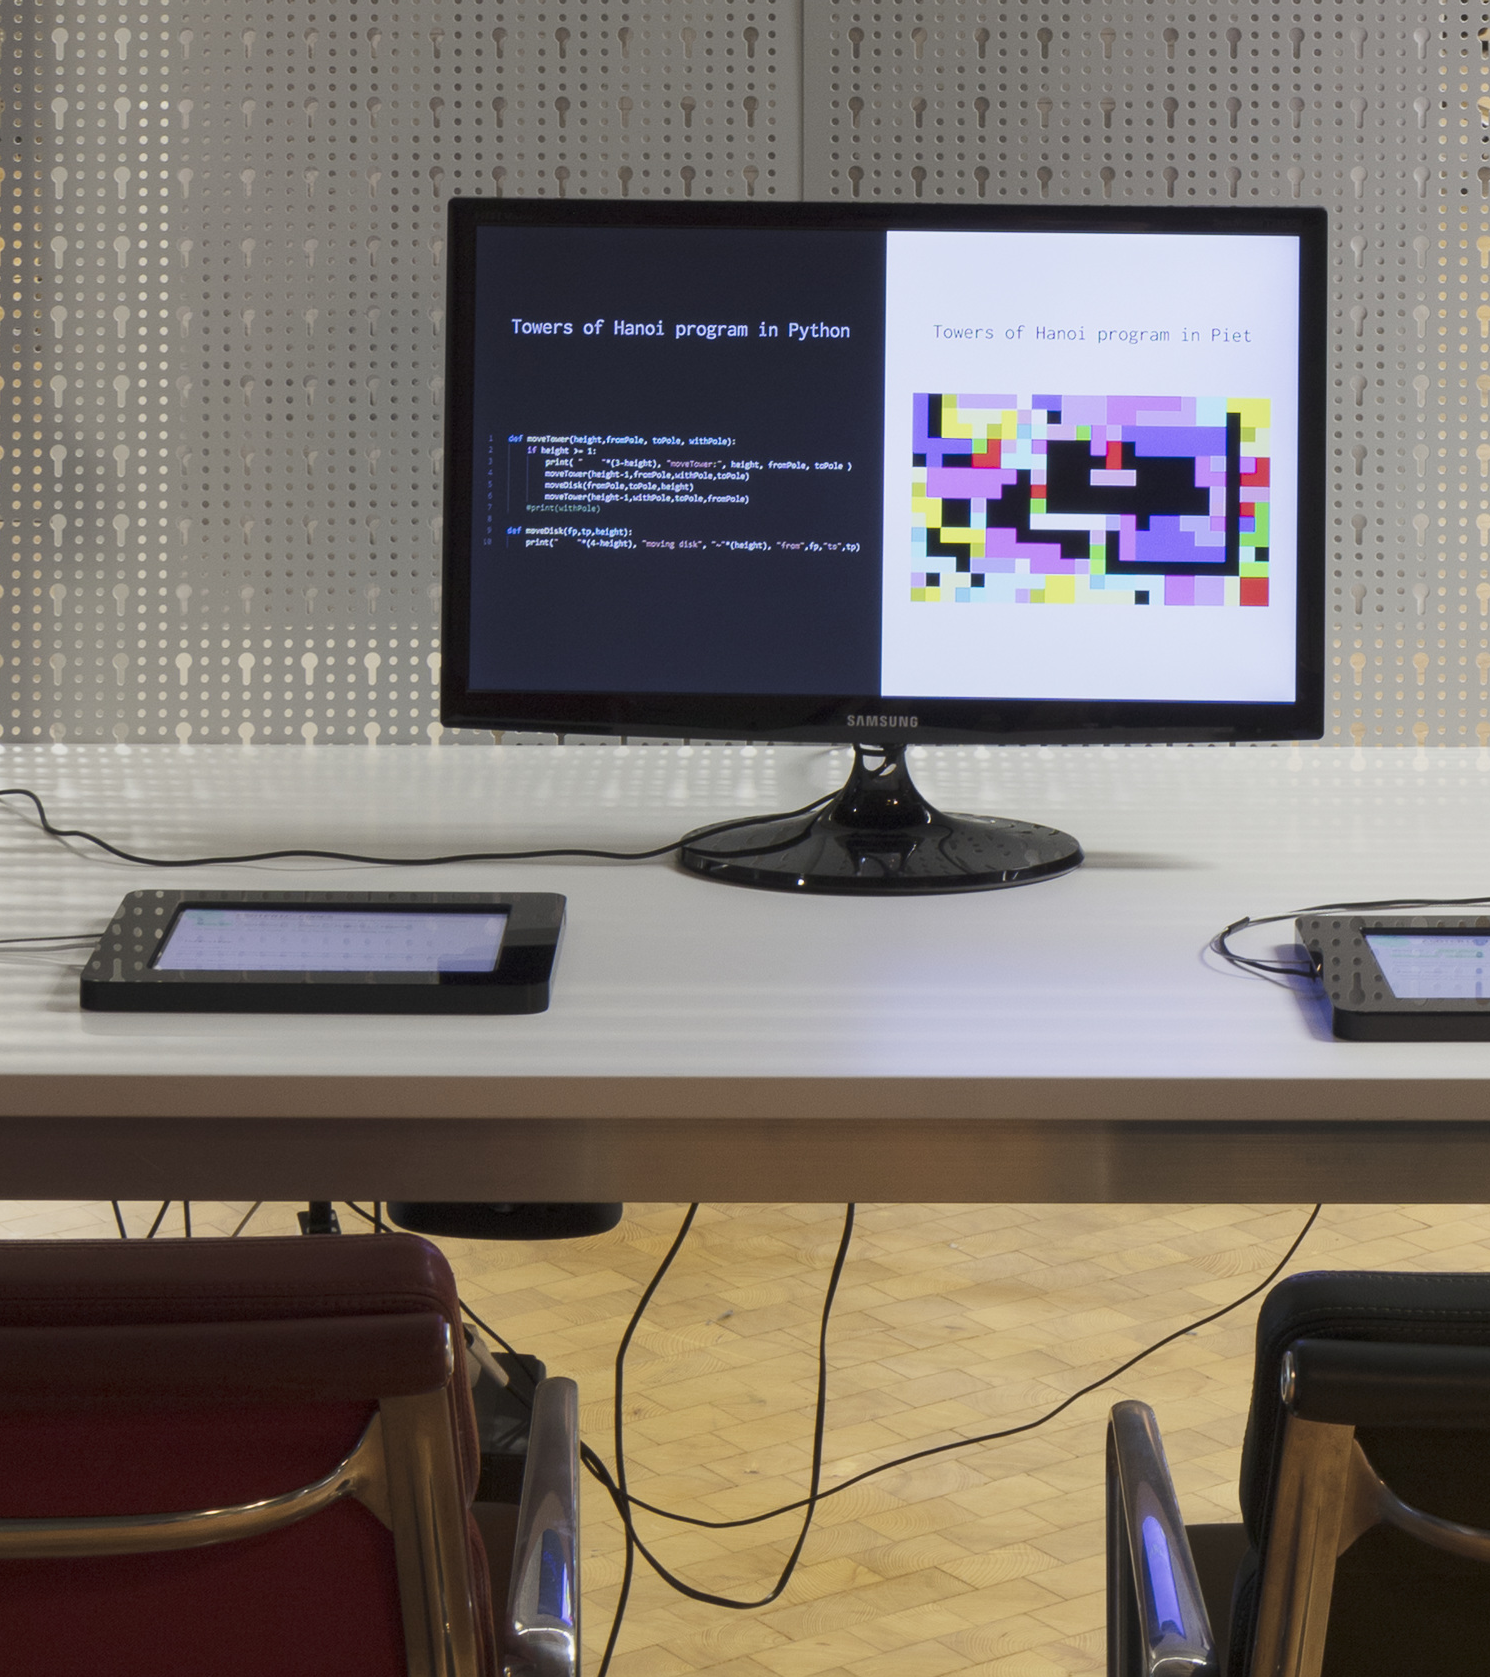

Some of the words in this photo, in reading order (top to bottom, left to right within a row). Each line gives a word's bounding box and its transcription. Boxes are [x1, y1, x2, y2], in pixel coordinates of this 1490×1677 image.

[511, 319, 573, 335] Towers
[583, 319, 604, 335] of
[614, 320, 664, 336] Hanoi
[676, 322, 748, 340] program
[759, 321, 778, 337] in
[788, 322, 850, 341] Python
[933, 325, 994, 339] Towers
[1005, 325, 1025, 340] of
[1037, 326, 1086, 341] Hanoi
[1098, 328, 1170, 344] program
[1182, 327, 1200, 342] in
[1212, 328, 1252, 343] Piet
[508, 435, 523, 443] def
[541, 447, 569, 456] height
[507, 527, 522, 535] def
[847, 715, 918, 727] SAMSUNG
